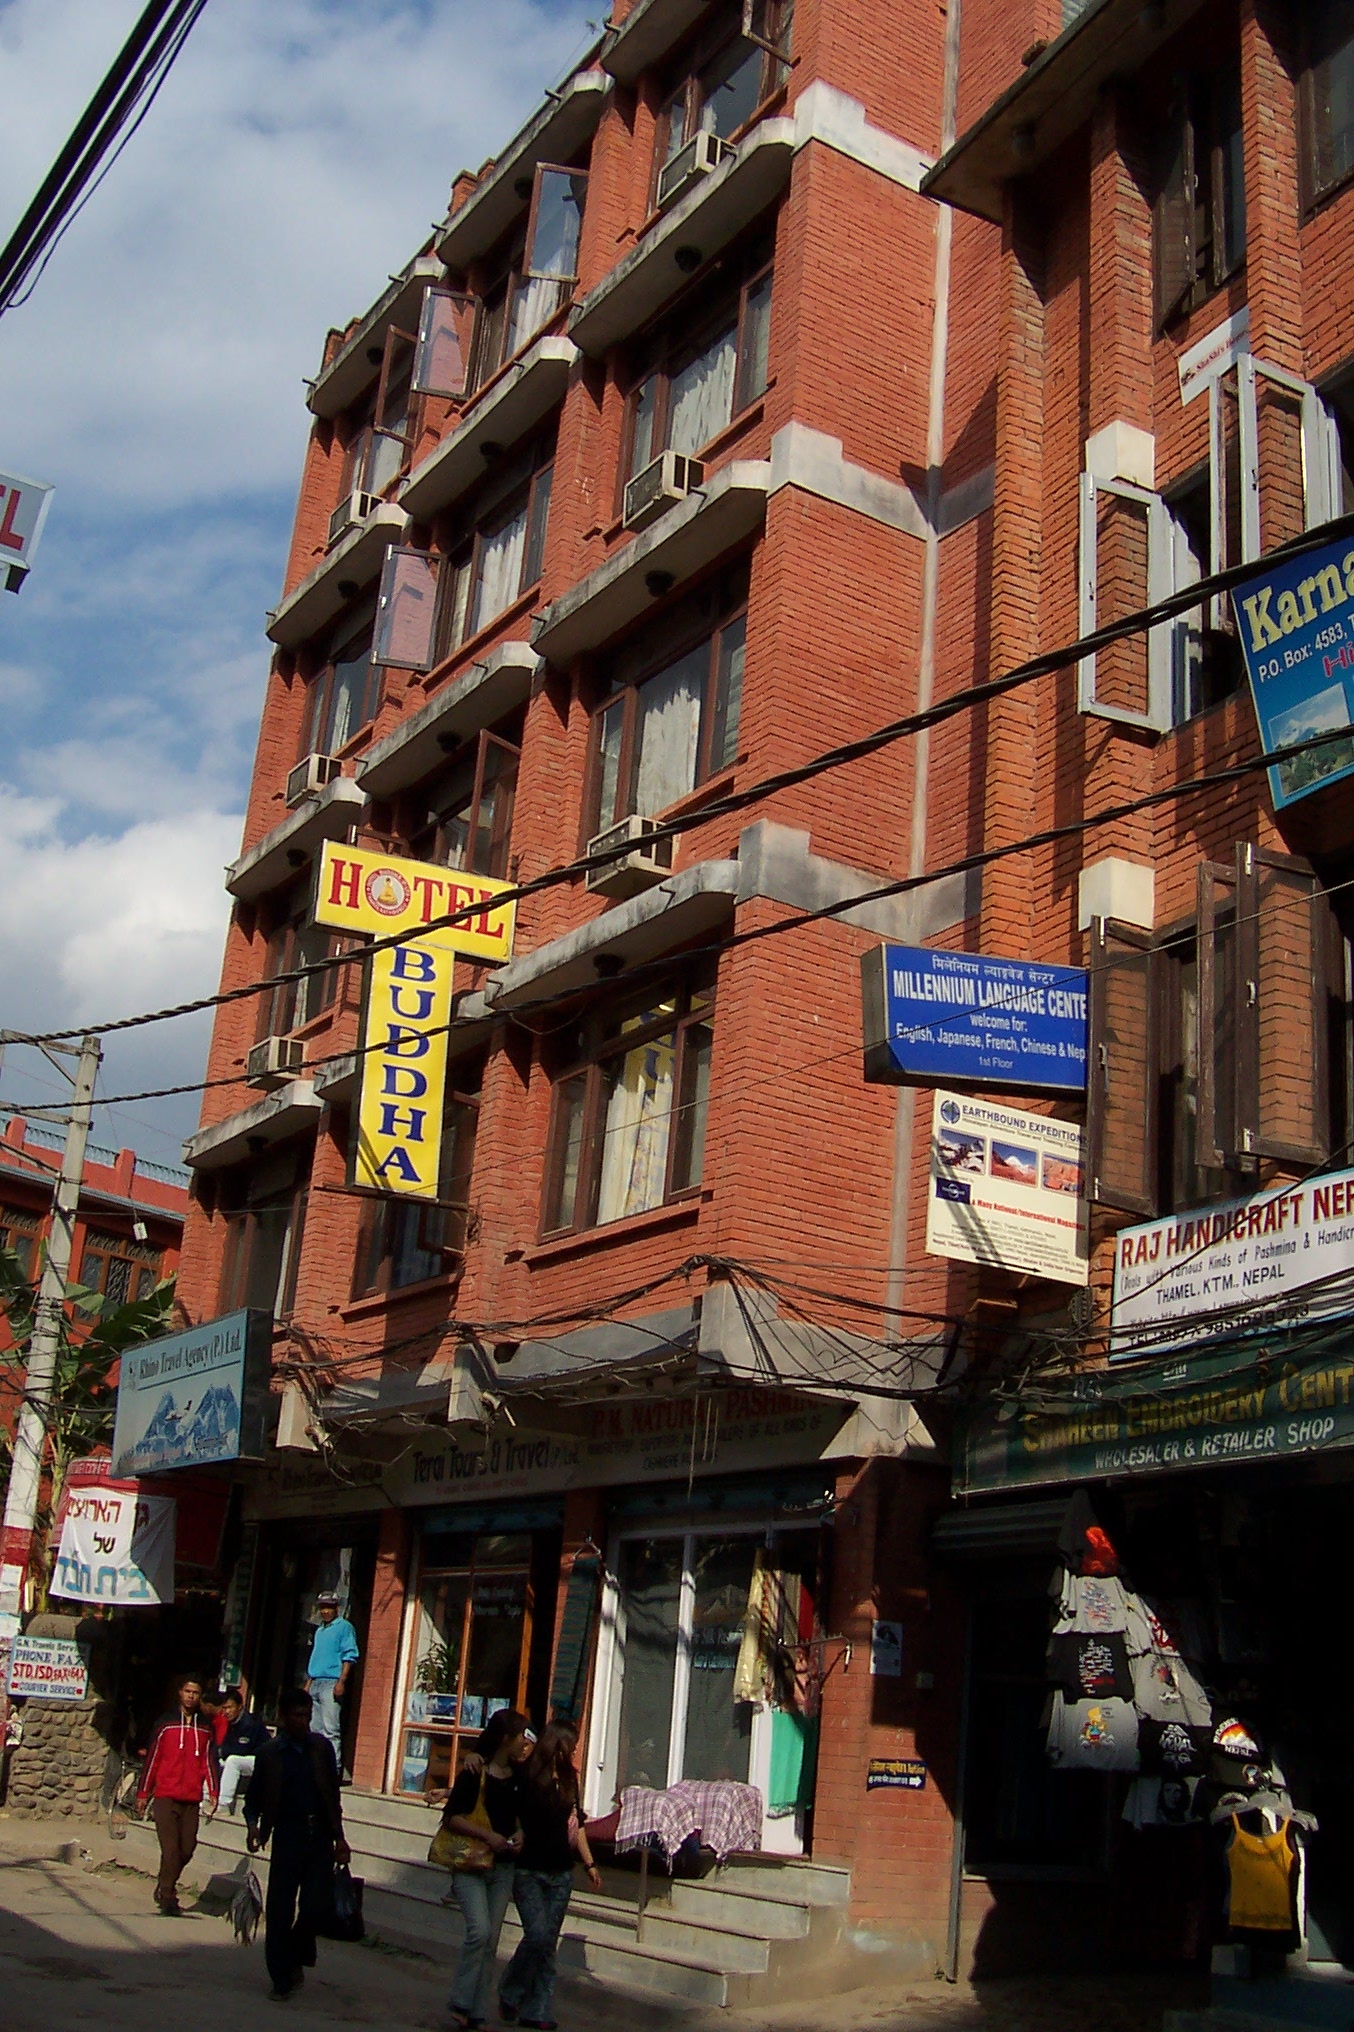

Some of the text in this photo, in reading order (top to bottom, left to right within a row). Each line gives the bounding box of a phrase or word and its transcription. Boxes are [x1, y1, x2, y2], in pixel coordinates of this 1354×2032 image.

[1258, 660, 1283, 682] P.O.
[1284, 644, 1313, 668] Box:
[1315, 622, 1348, 650] 4583,
[328, 858, 505, 939] HOTEL
[893, 970, 1087, 1020] MILLENNIUM LANGUAGE CENTE
[896, 1022, 935, 1044] English,
[937, 1028, 985, 1050] Japanese,
[985, 1033, 1020, 1052] French,
[1021, 1037, 1056, 1056] Chinese
[1058, 1043, 1066, 1057] &
[969, 1013, 1011, 1031] welcome
[375, 944, 436, 1184] BUDDHA
[992, 1057, 1013, 1069] Floor
[962, 1104, 1027, 1129] EARTHBOUND
[1120, 1229, 1162, 1270] RAJ
[1166, 1191, 1305, 1259] HANDICRAFT
[1208, 1255, 1232, 1274] Kinds
[1238, 1249, 1248, 1264] of
[1242, 1263, 1285, 1287] NEPAL
[1127, 1386, 1266, 1438] EMBROIDERY
[1094, 1416, 1335, 1469] WHOLESALER & RETAILER SHOP
[93, 1531, 116, 1554] של
[94, 1565, 150, 1598] בית
